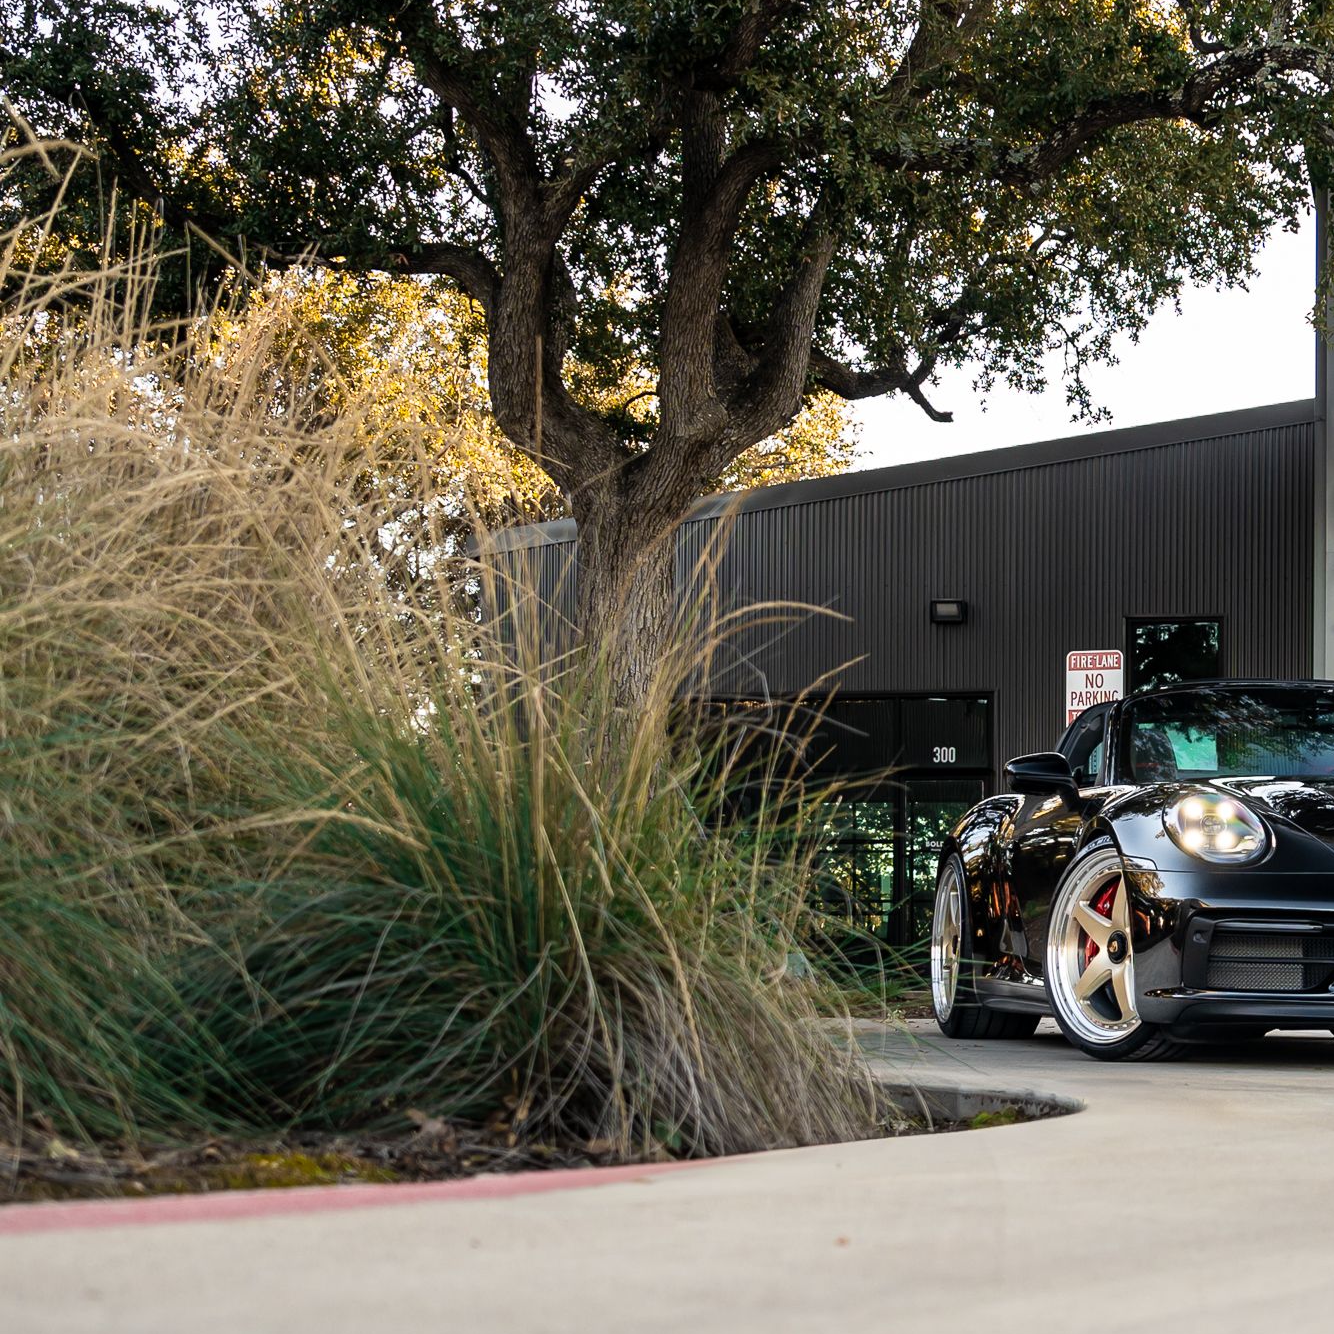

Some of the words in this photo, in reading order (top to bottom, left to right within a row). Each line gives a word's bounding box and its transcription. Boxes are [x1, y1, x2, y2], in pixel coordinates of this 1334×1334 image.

[1071, 655, 1093, 668] FIRE
[1096, 655, 1119, 667] LANE
[1085, 673, 1104, 689] NO
[932, 746, 956, 763] 300
